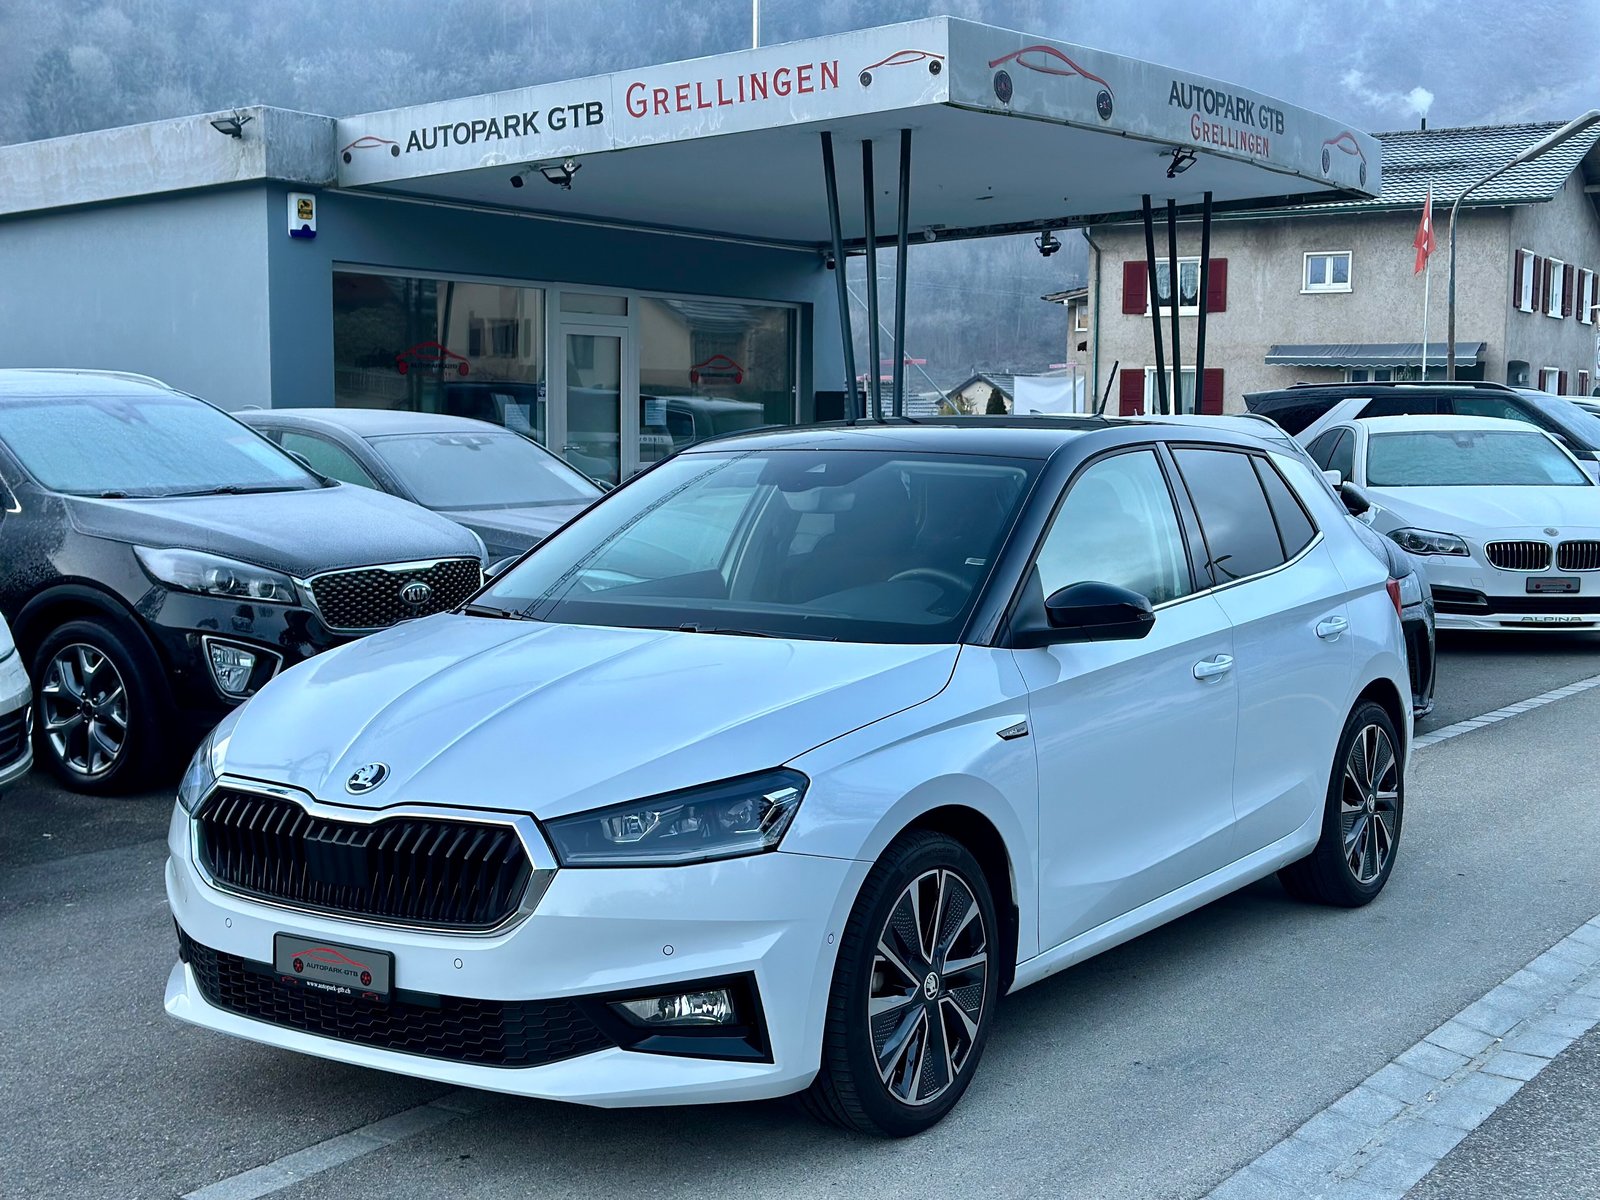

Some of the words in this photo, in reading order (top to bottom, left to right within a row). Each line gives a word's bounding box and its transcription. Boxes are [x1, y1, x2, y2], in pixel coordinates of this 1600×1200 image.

[626, 60, 840, 118] GRELLINGEN
[1168, 80, 1255, 127] AUTOPARK
[1259, 104, 1285, 135] GTB
[405, 111, 539, 153] AUTOPARK
[547, 100, 604, 131] GTB
[1190, 113, 1269, 158] GRELLINGEN
